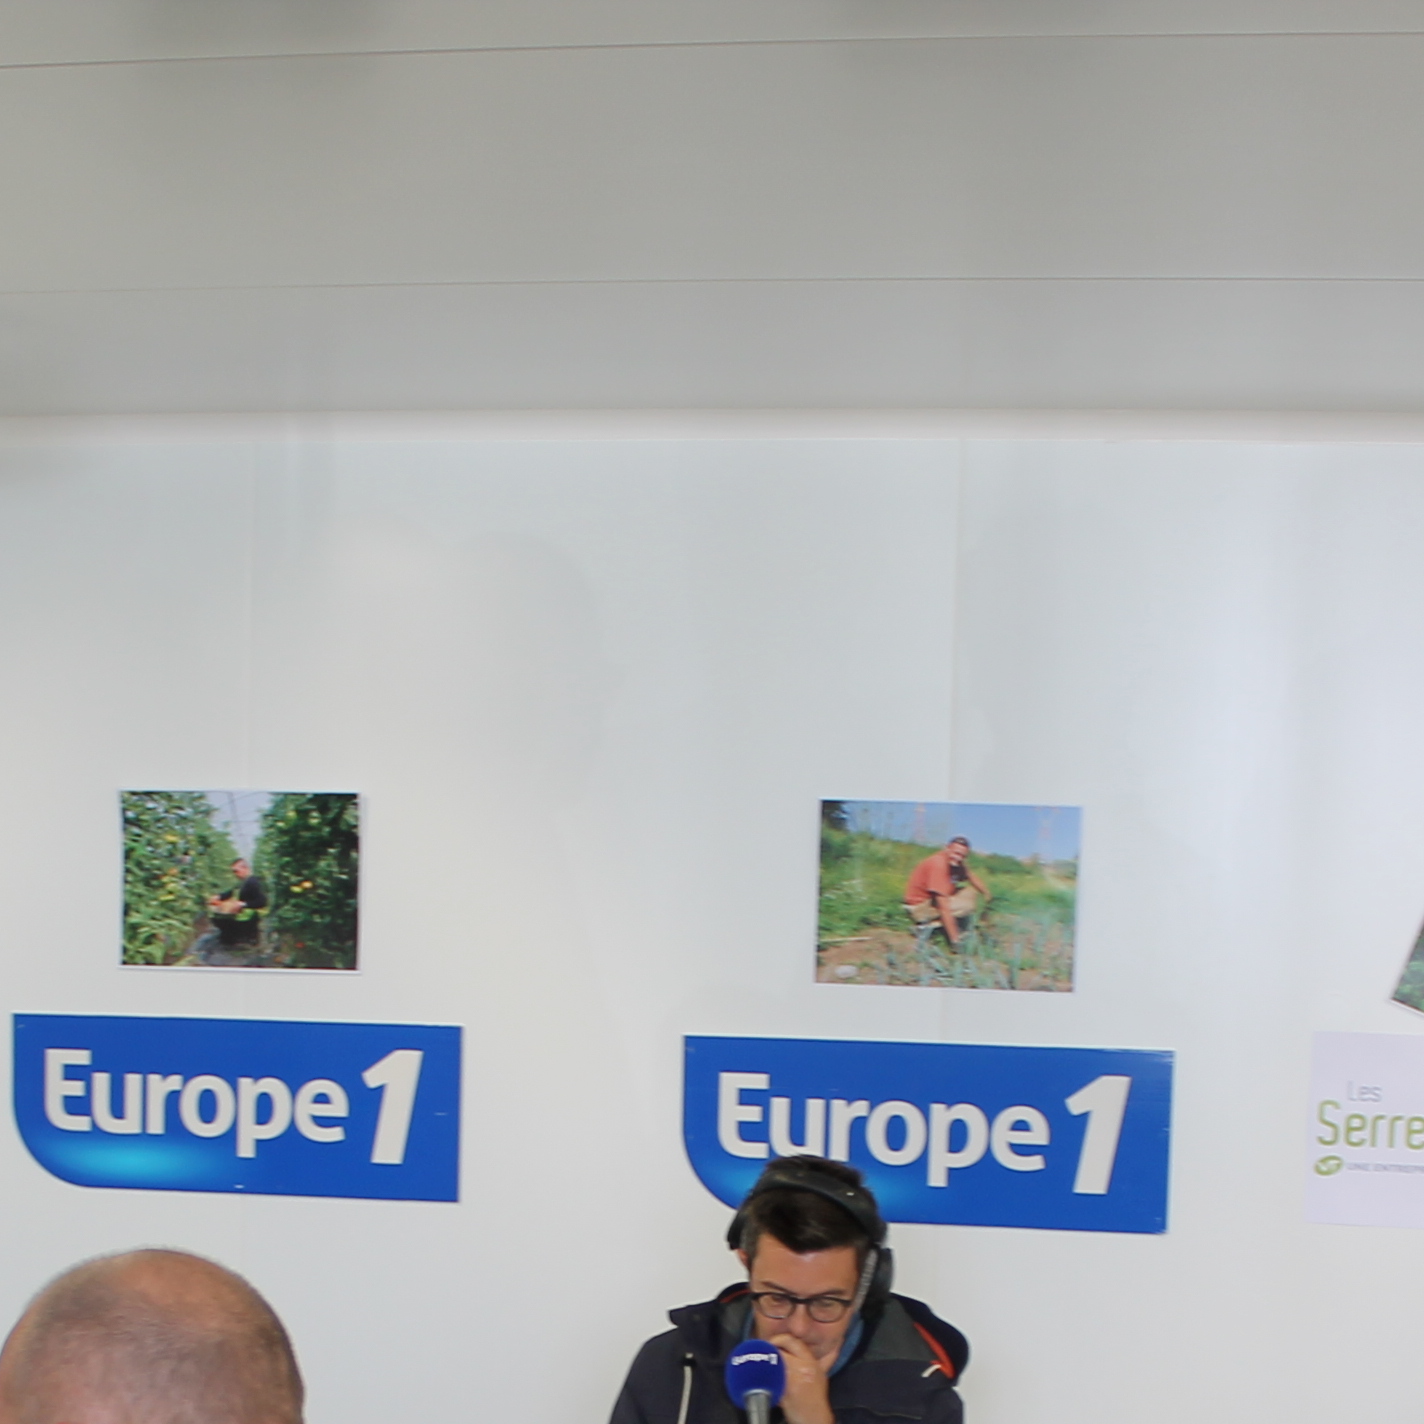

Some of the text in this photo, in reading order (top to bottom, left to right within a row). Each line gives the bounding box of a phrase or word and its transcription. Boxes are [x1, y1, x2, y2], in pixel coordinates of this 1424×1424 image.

[43, 1047, 424, 1166] Europe 1
[716, 1070, 1133, 1196] Europe 1
[1346, 1080, 1383, 1103] Les
